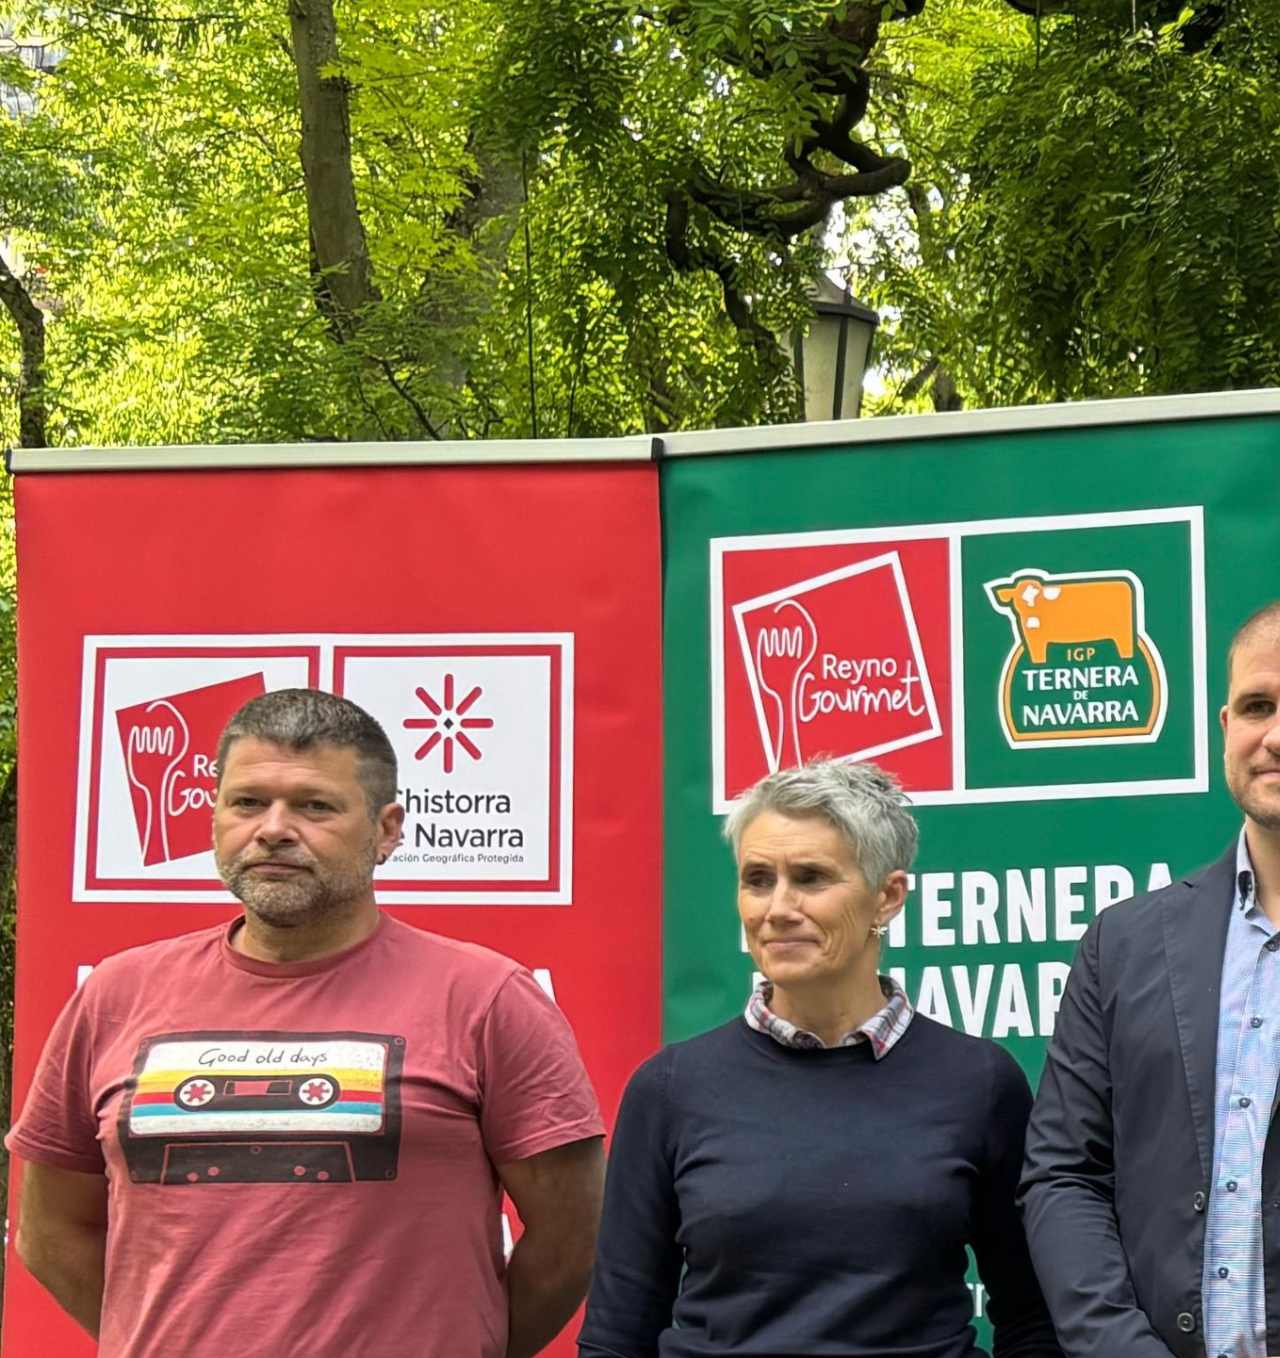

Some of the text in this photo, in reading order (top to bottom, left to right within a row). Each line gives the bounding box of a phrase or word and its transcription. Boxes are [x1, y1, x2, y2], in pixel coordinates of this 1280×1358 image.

[1067, 647, 1096, 662] IGP
[823, 654, 898, 686] Reyno
[1022, 664, 1140, 692] TERNERA
[799, 658, 926, 723] Gourmet
[1073, 690, 1089, 701] DE
[1022, 699, 1139, 727] NAVARRA
[416, 822, 525, 849] Navarra
[392, 853, 525, 866] ación Geográfica Protegida
[198, 1047, 328, 1067] Good old days
